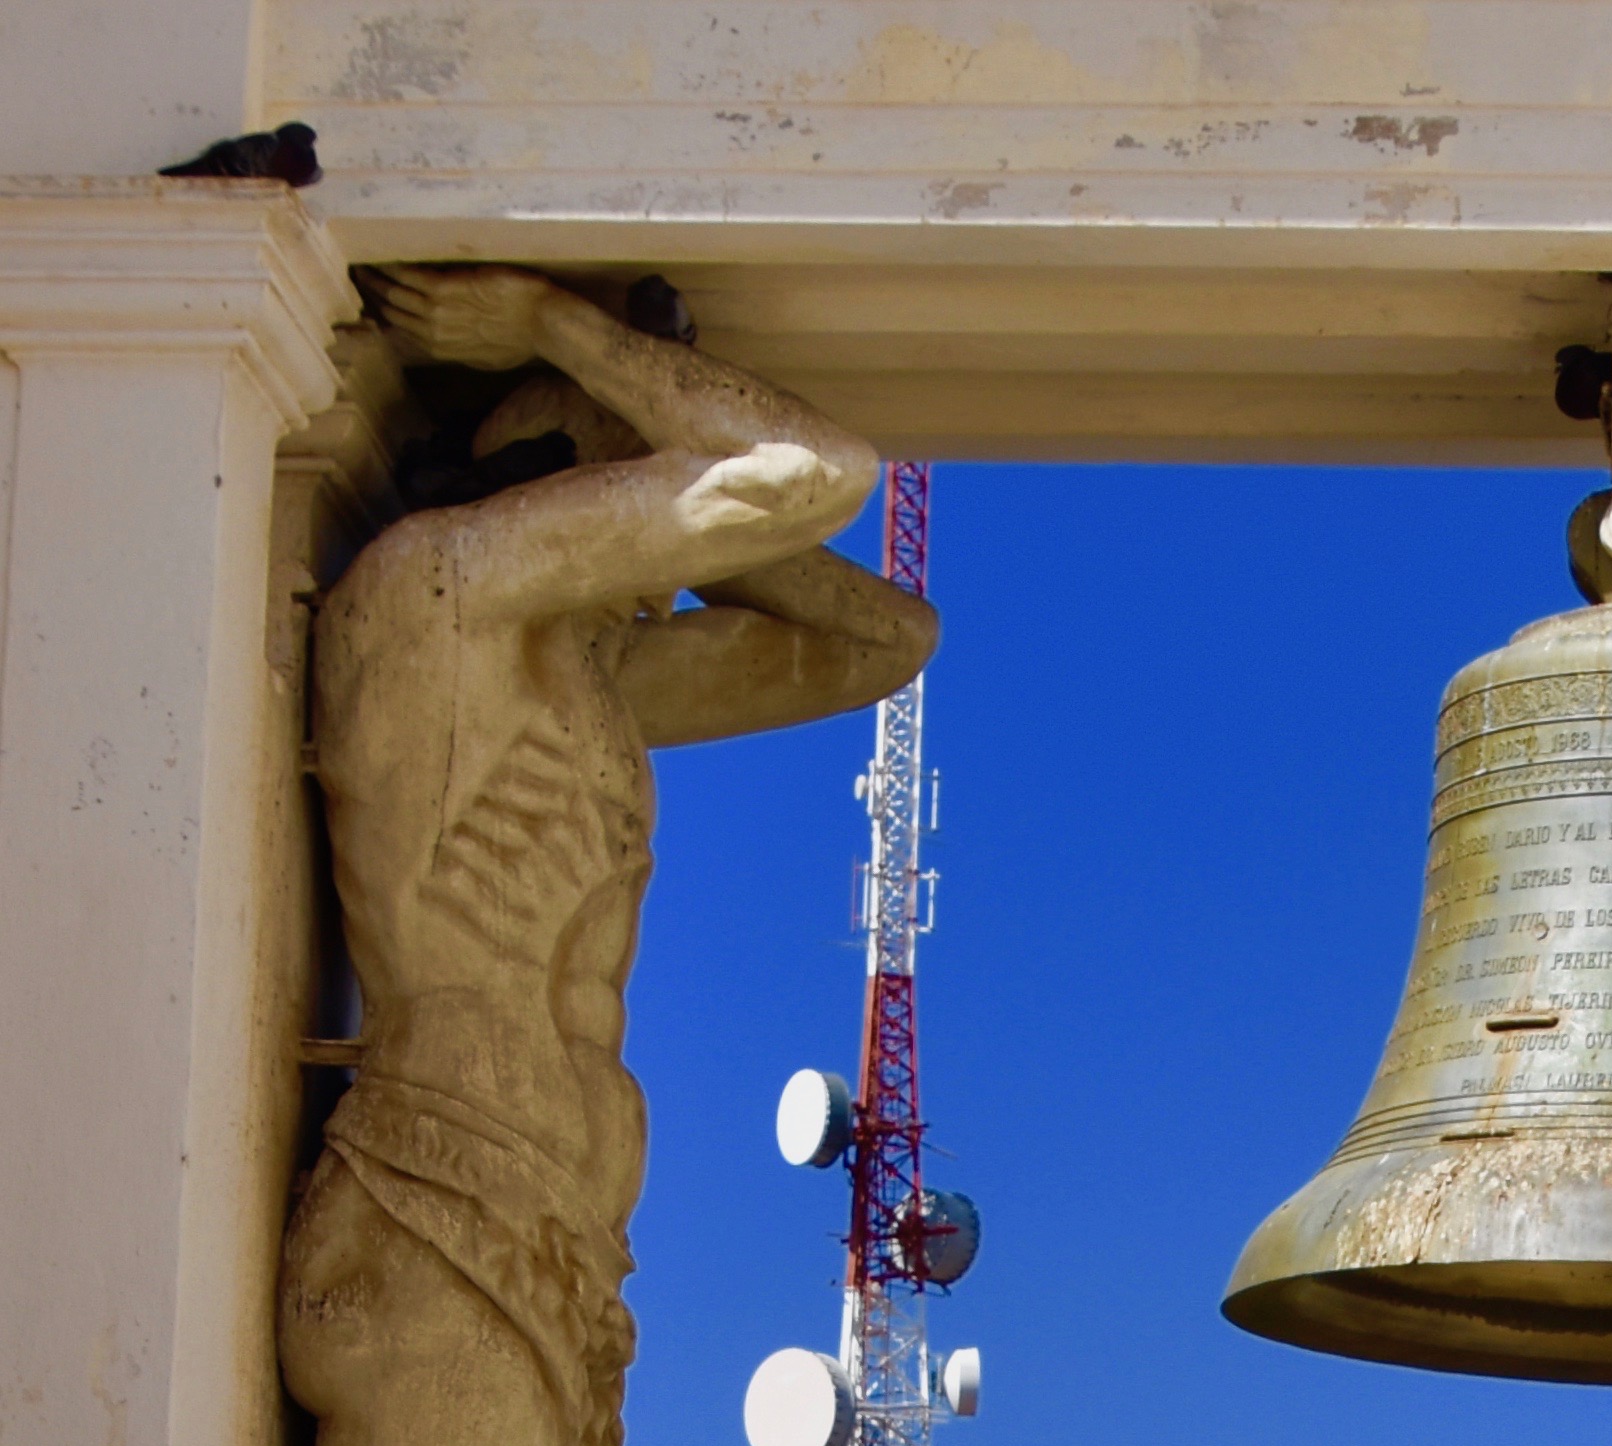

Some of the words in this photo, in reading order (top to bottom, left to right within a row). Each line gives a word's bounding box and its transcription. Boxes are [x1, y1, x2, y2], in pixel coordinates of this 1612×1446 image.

[1553, 731, 1591, 752] 1968
[1505, 827, 1550, 850] DARIO
[1574, 820, 1597, 842] AL
[1509, 866, 1573, 891] LETRAS
[1553, 909, 1576, 929] DE
[1494, 1032, 1571, 1056] AUGUSTO
